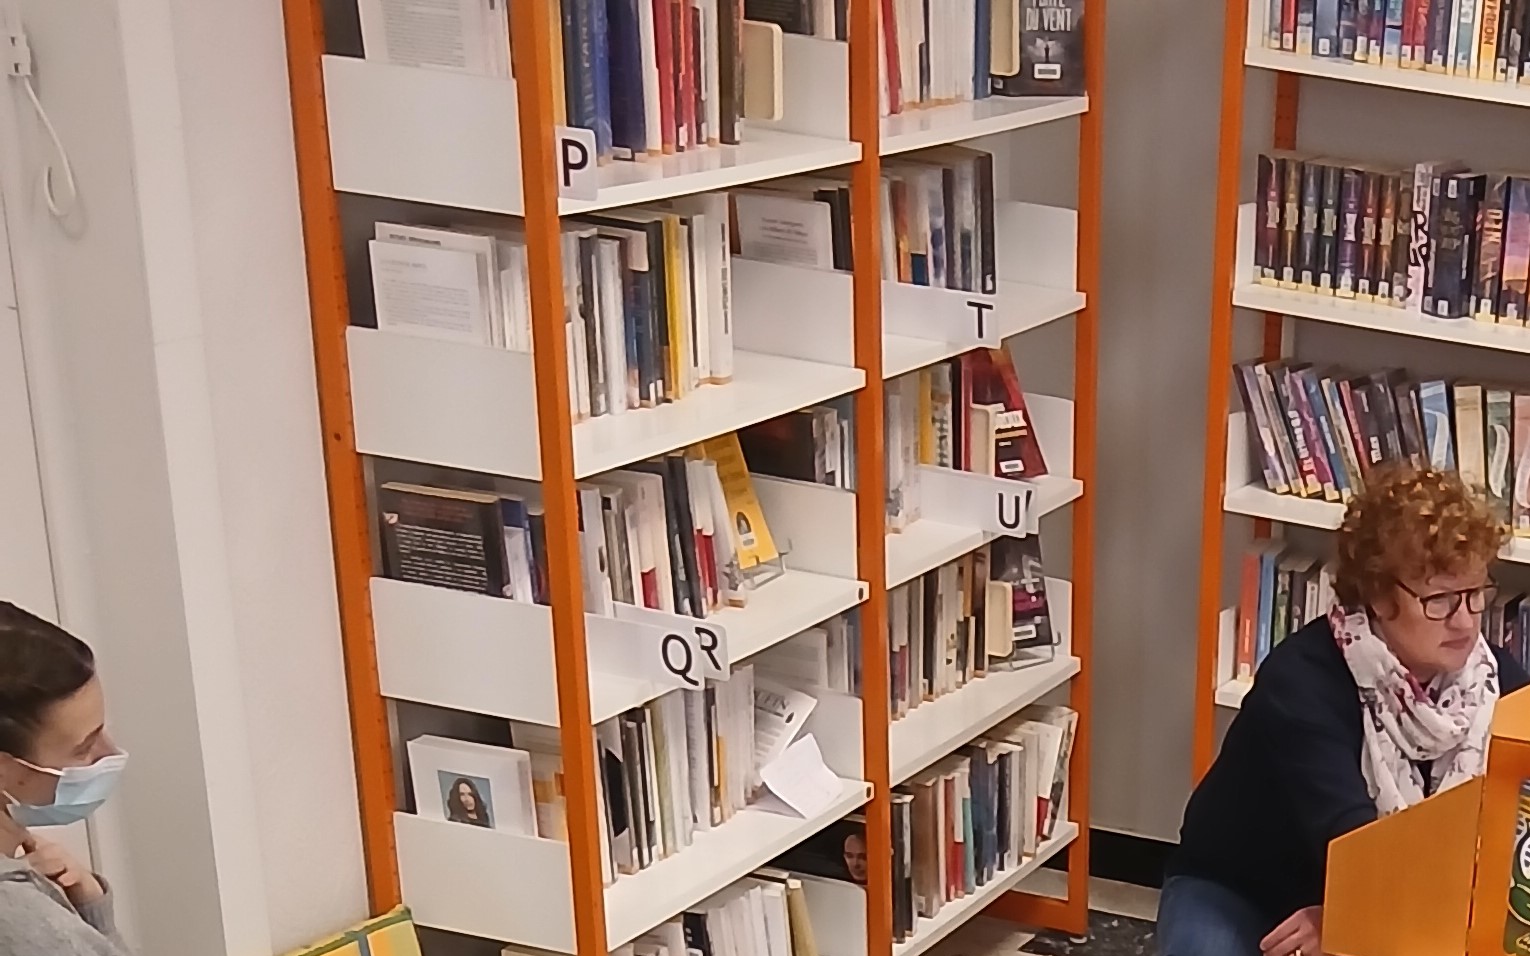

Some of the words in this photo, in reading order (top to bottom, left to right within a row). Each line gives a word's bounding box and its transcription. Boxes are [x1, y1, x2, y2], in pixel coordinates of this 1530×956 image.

[1026, 8, 1039, 31] DU
[1042, 8, 1072, 31] VENT
[561, 138, 588, 187] P
[966, 301, 994, 339] T
[998, 492, 1020, 529] U
[661, 633, 699, 687] Q
[694, 626, 722, 672] R
